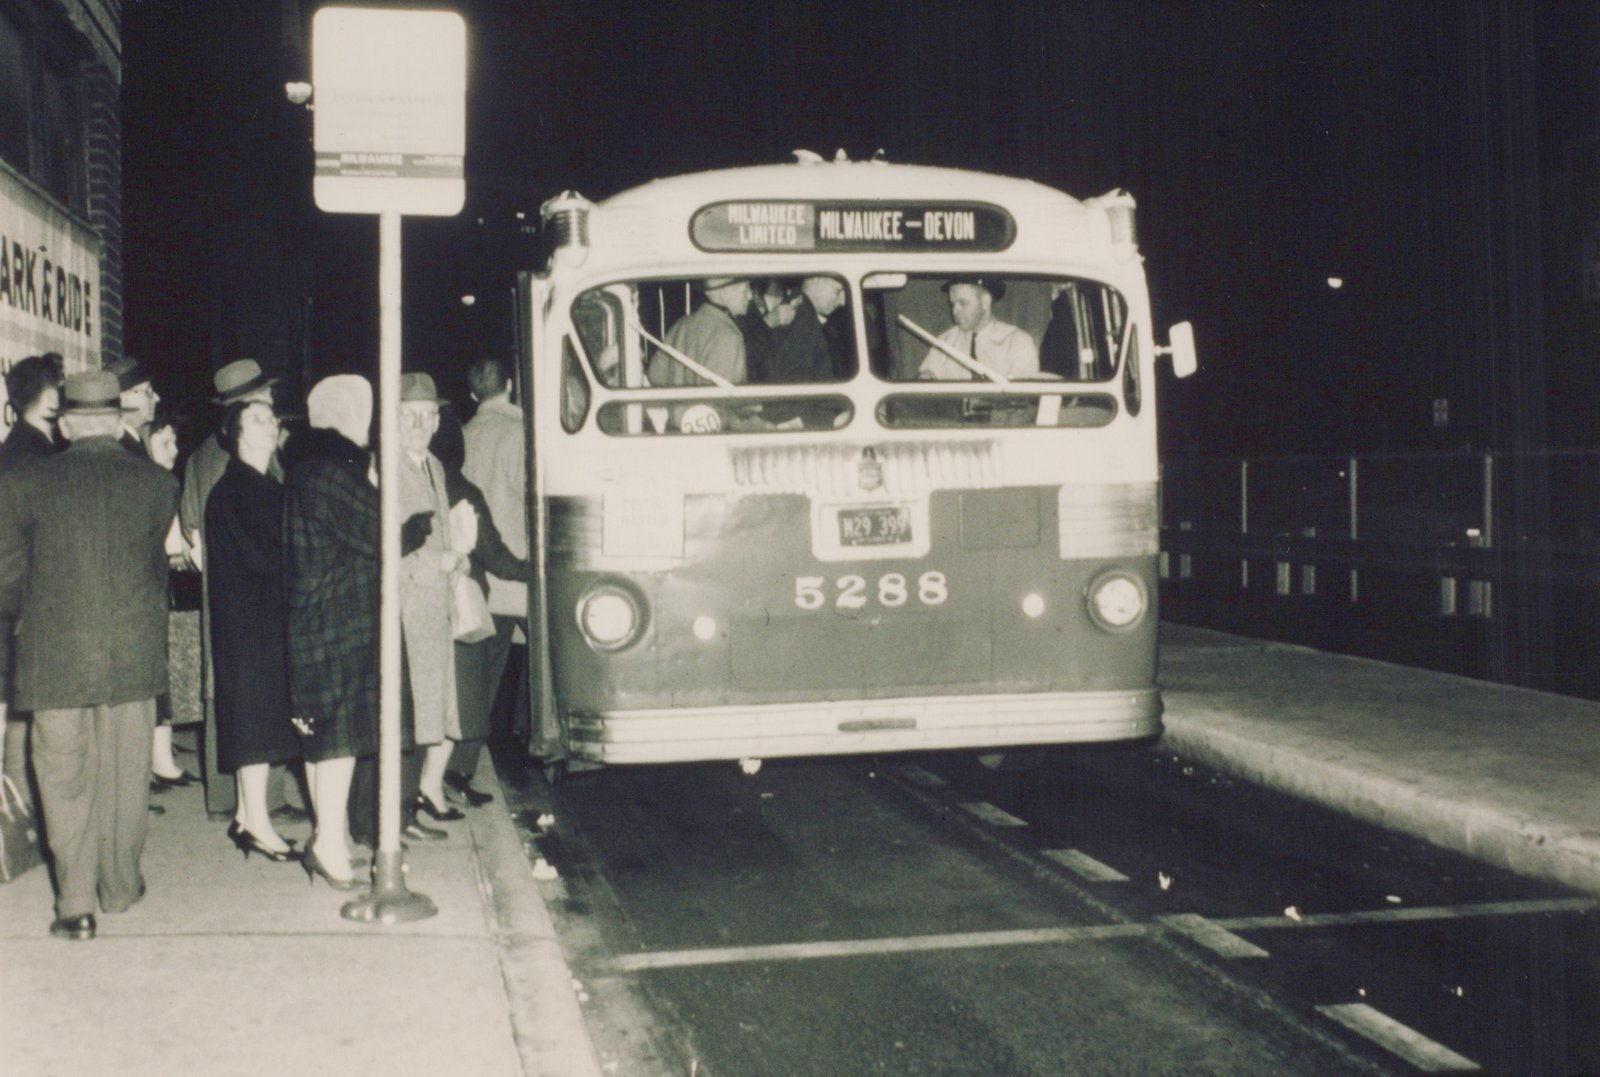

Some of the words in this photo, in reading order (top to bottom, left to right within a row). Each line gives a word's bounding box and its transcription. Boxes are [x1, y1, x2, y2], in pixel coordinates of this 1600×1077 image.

[728, 204, 805, 224] MILWAUKEE
[739, 225, 796, 245] LIMITED
[42, 259, 52, 322] &
[57, 266, 91, 336] RIDE
[795, 571, 947, 610] 5288
